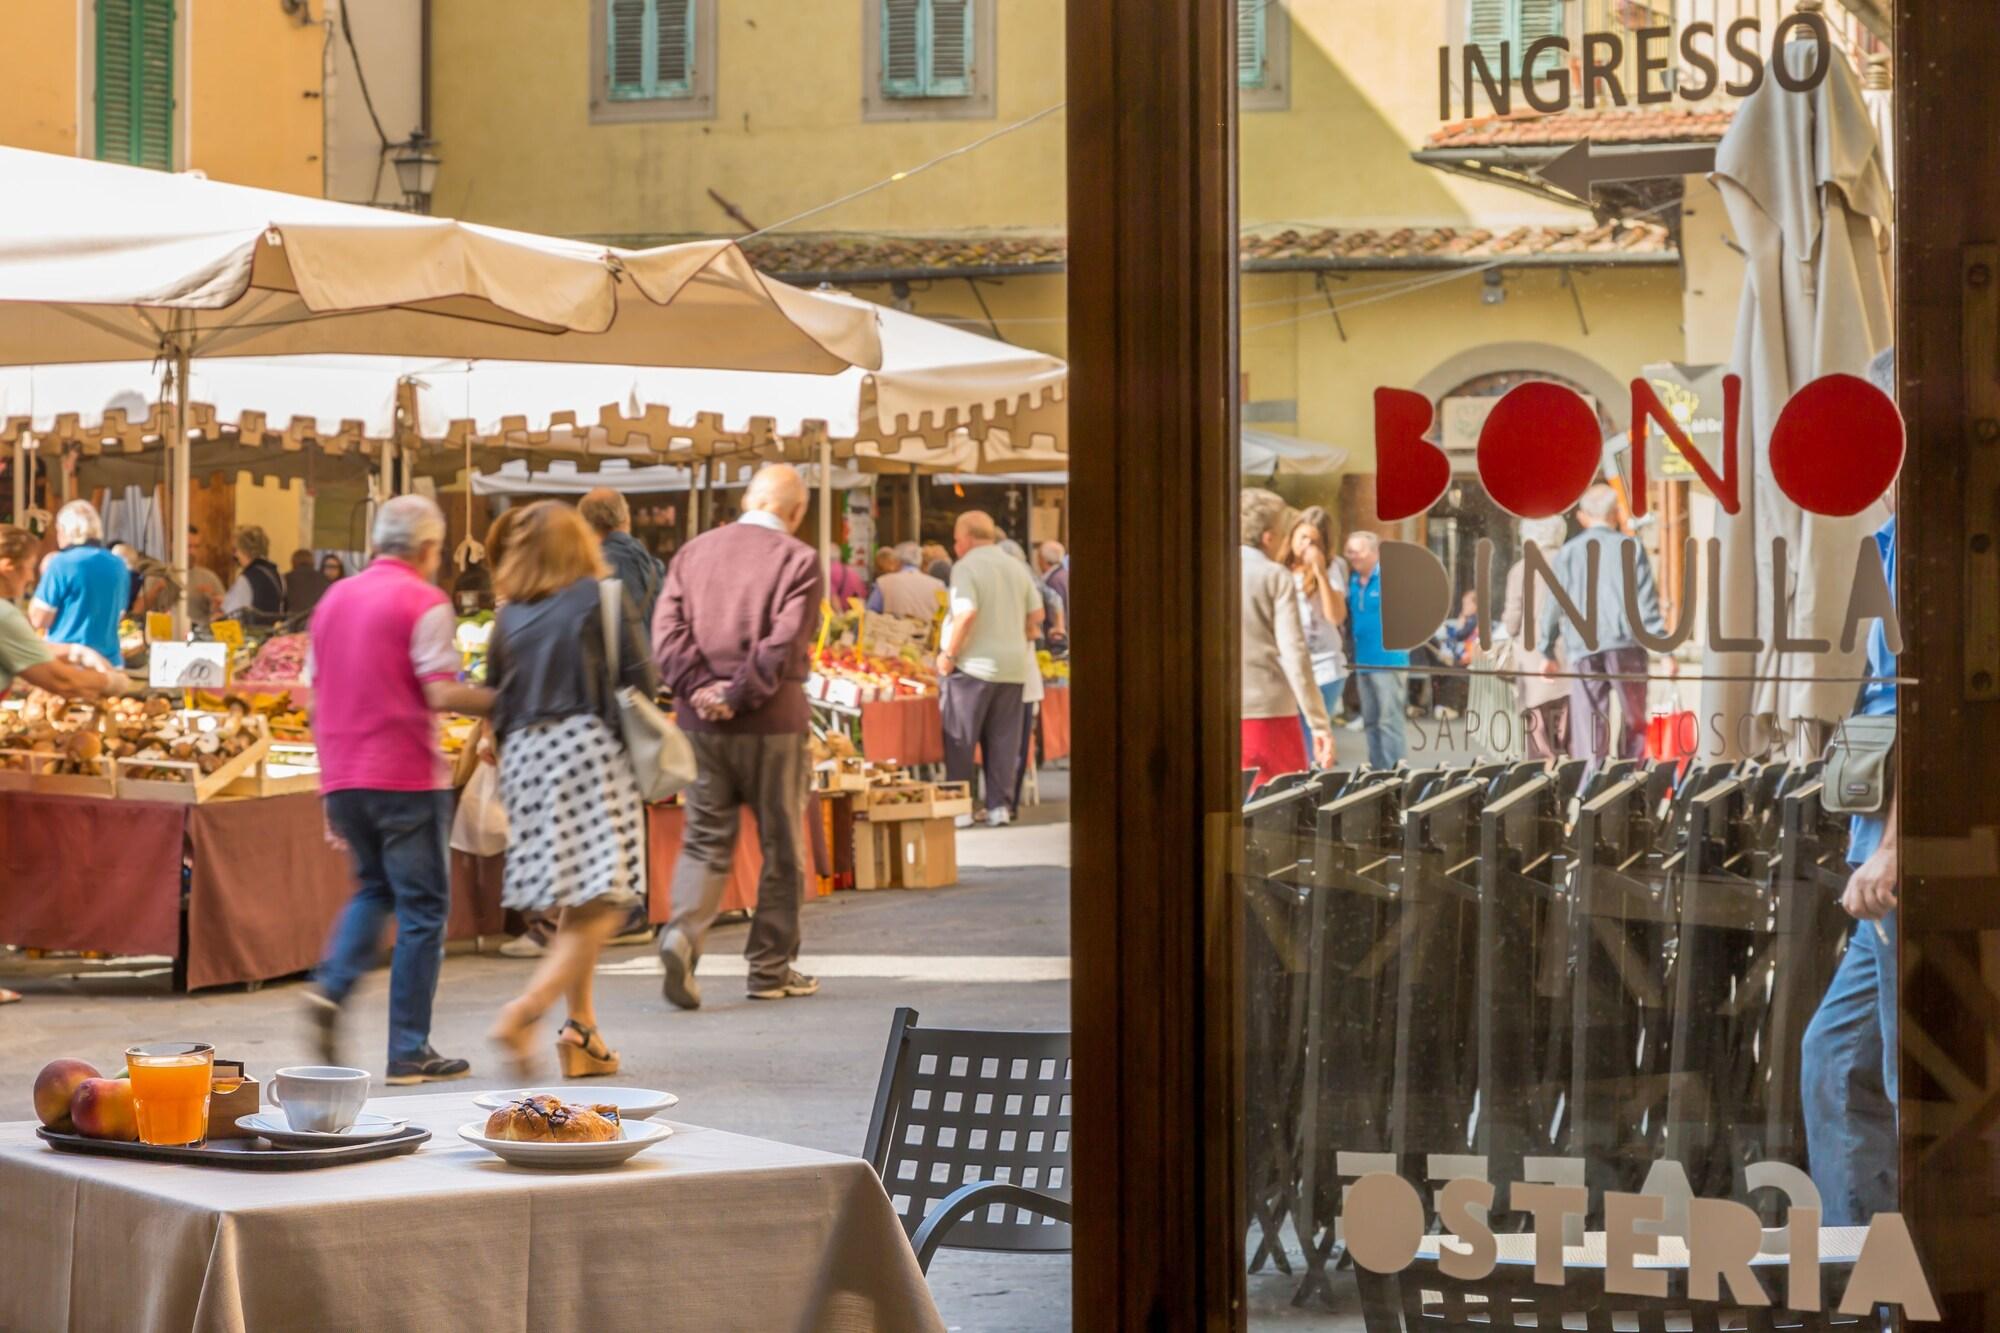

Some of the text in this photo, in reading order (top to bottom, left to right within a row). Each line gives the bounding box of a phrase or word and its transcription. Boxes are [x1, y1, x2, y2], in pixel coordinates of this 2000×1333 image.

[1439, 12, 1831, 121] INGRESSO
[1374, 373, 1906, 521] BONO
[1651, 710, 1851, 759] TOSCANA
[1343, 1172, 1941, 1321] OSTERIA
